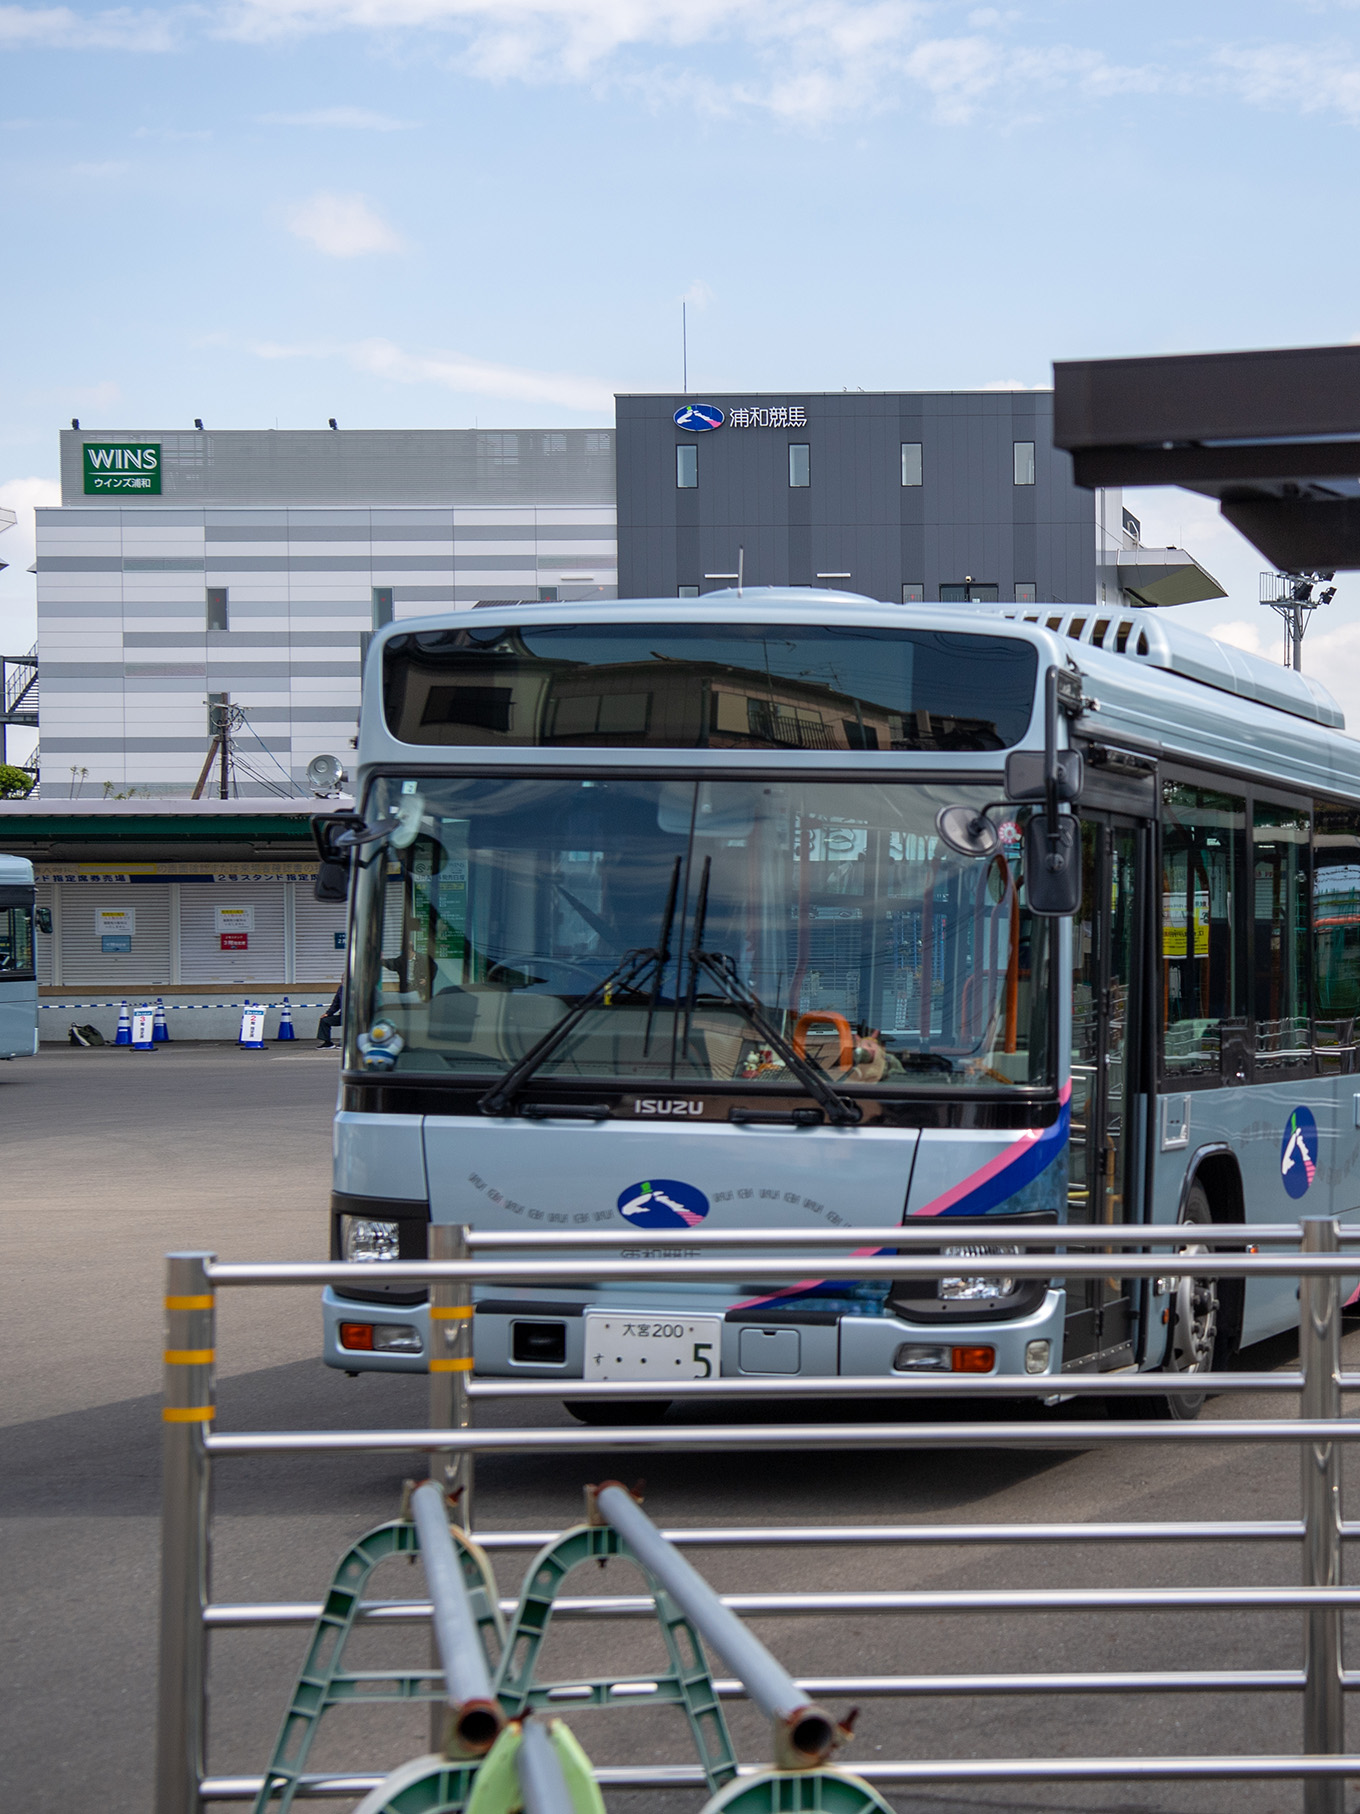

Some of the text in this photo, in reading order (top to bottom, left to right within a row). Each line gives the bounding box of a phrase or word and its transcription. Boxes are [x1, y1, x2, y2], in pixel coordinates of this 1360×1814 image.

[729, 406, 808, 428] 浦和競馬
[87, 448, 158, 470] WINS
[94, 478, 152, 489] ウインズ浦和
[634, 1099, 704, 1115] ISUZU
[693, 1343, 713, 1379] 5
